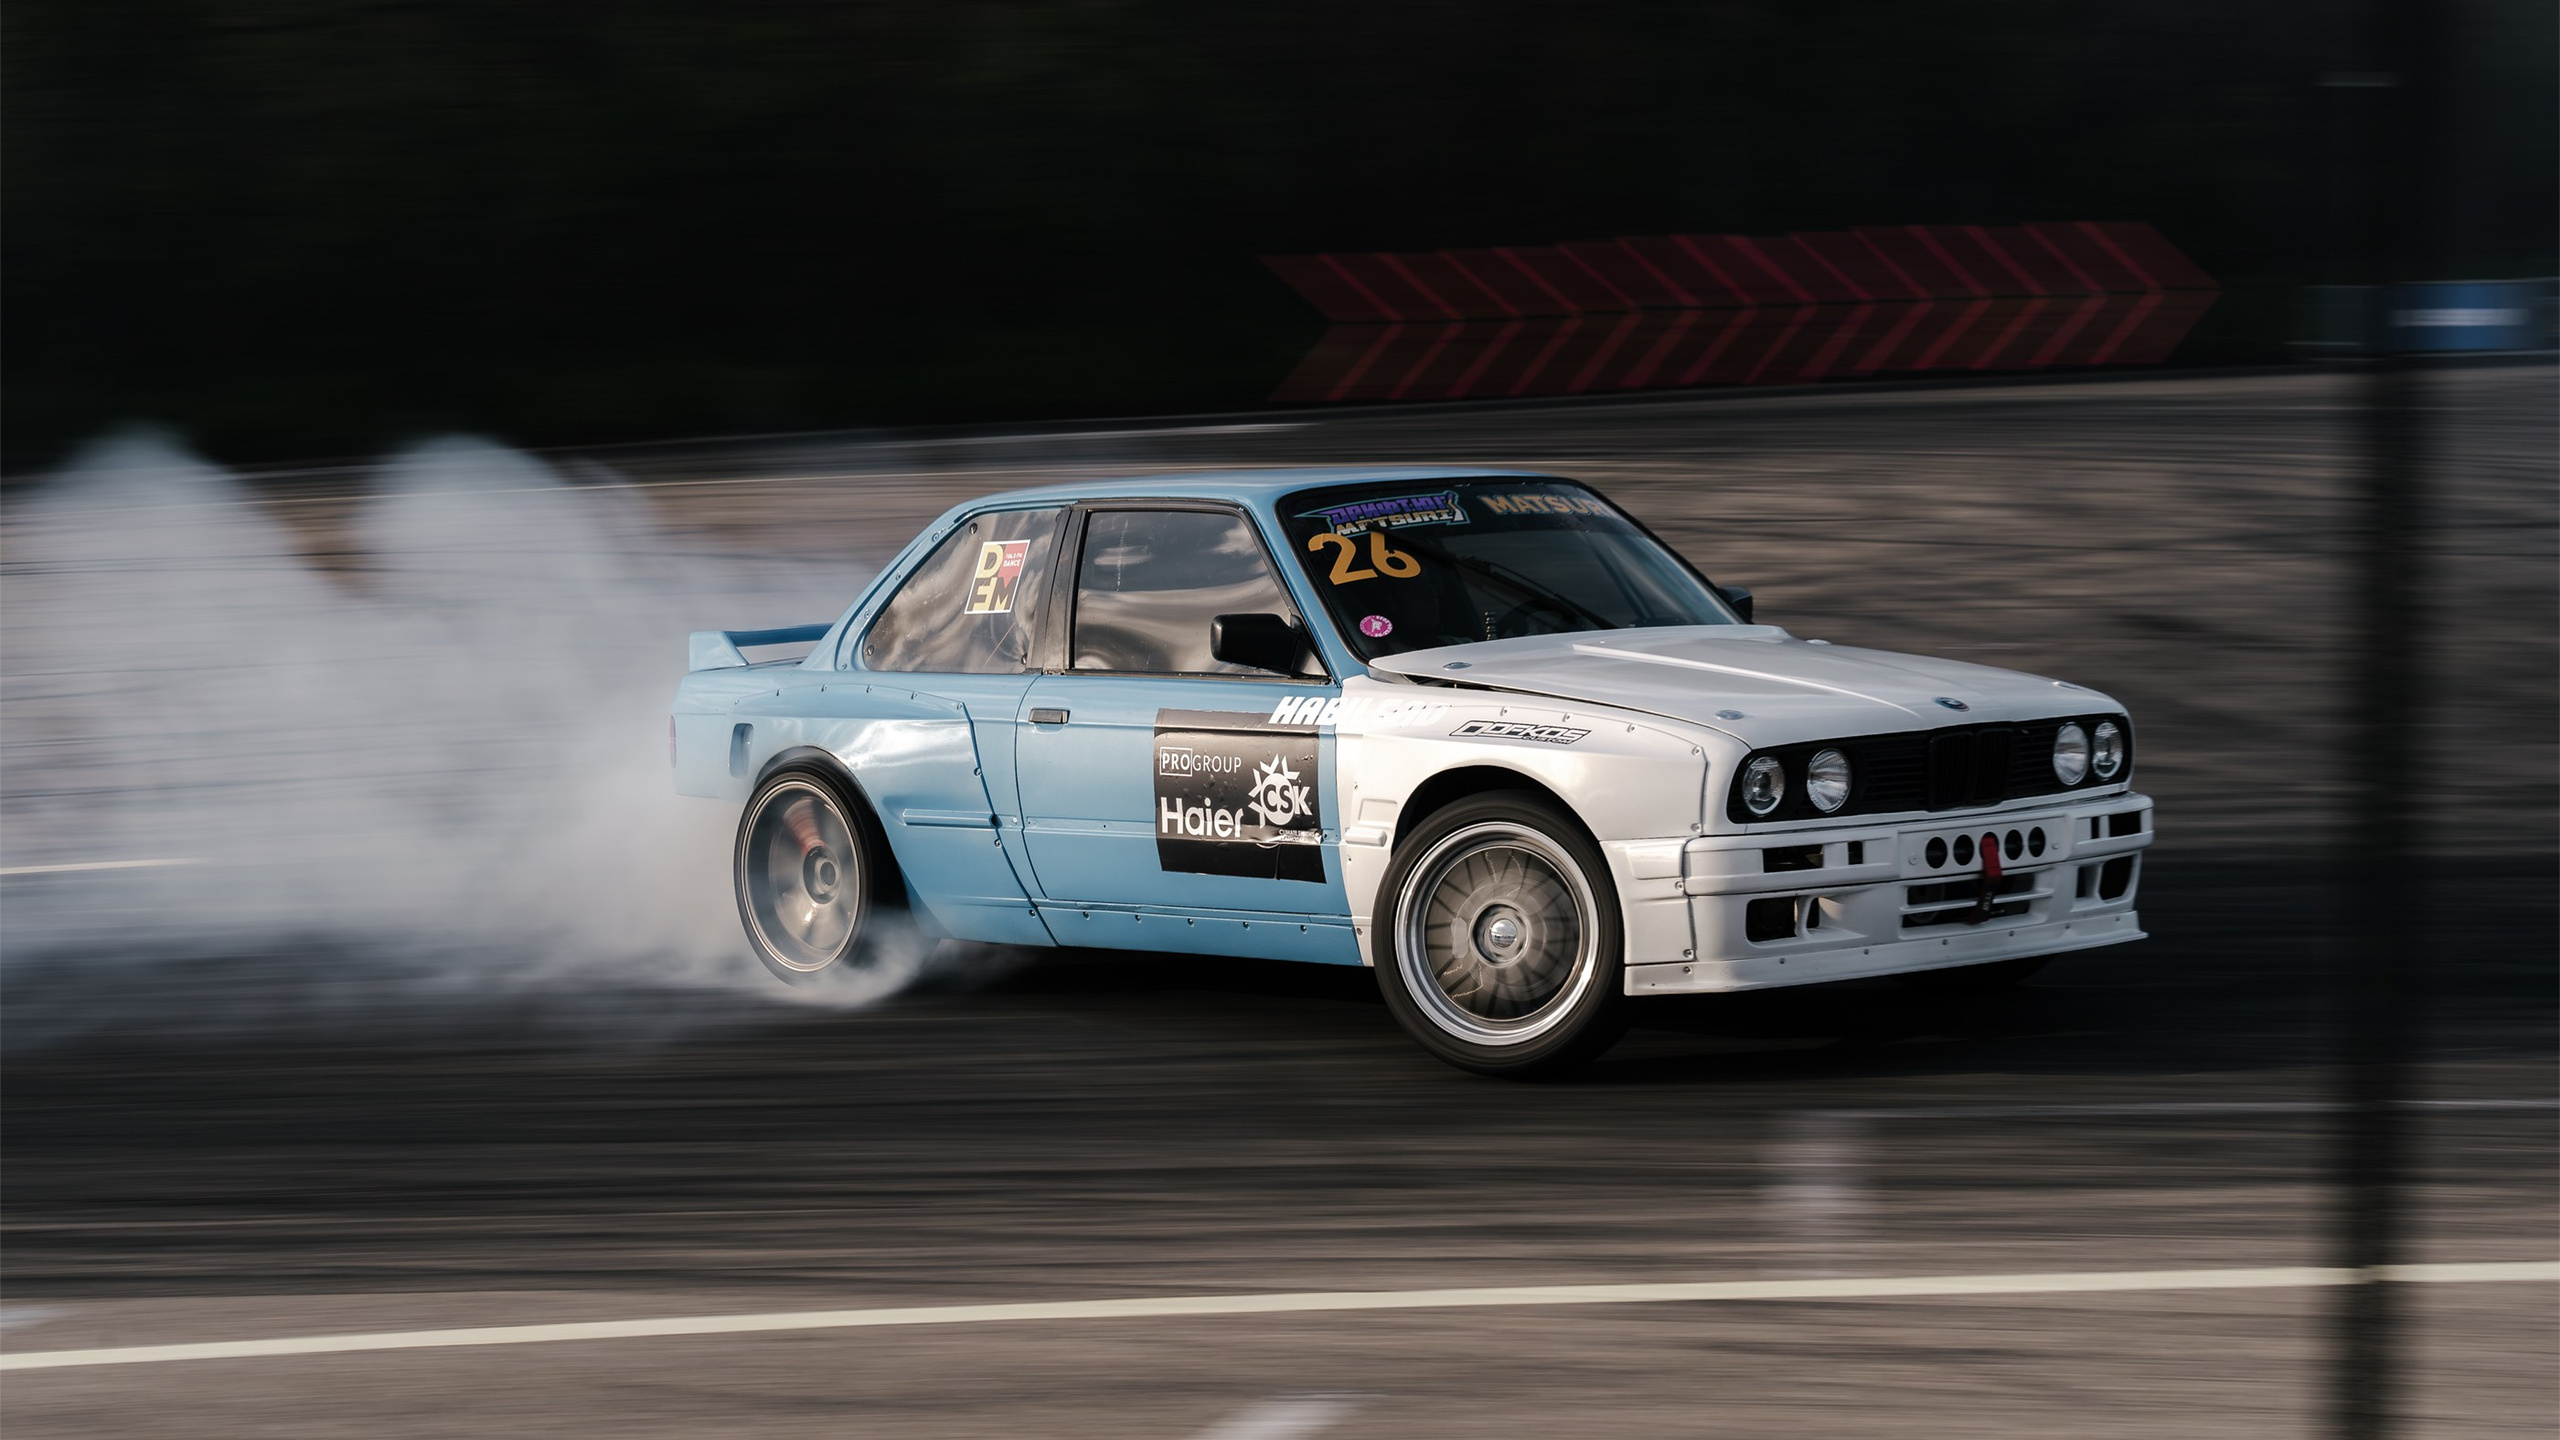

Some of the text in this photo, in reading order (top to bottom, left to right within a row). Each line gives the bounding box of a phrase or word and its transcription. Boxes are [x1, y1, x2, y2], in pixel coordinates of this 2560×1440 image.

[1003, 560, 1021, 568] DANCE
[1307, 532, 1421, 585] 26
[1160, 796, 1244, 838] Haier
[1263, 783, 1312, 816] CSK
